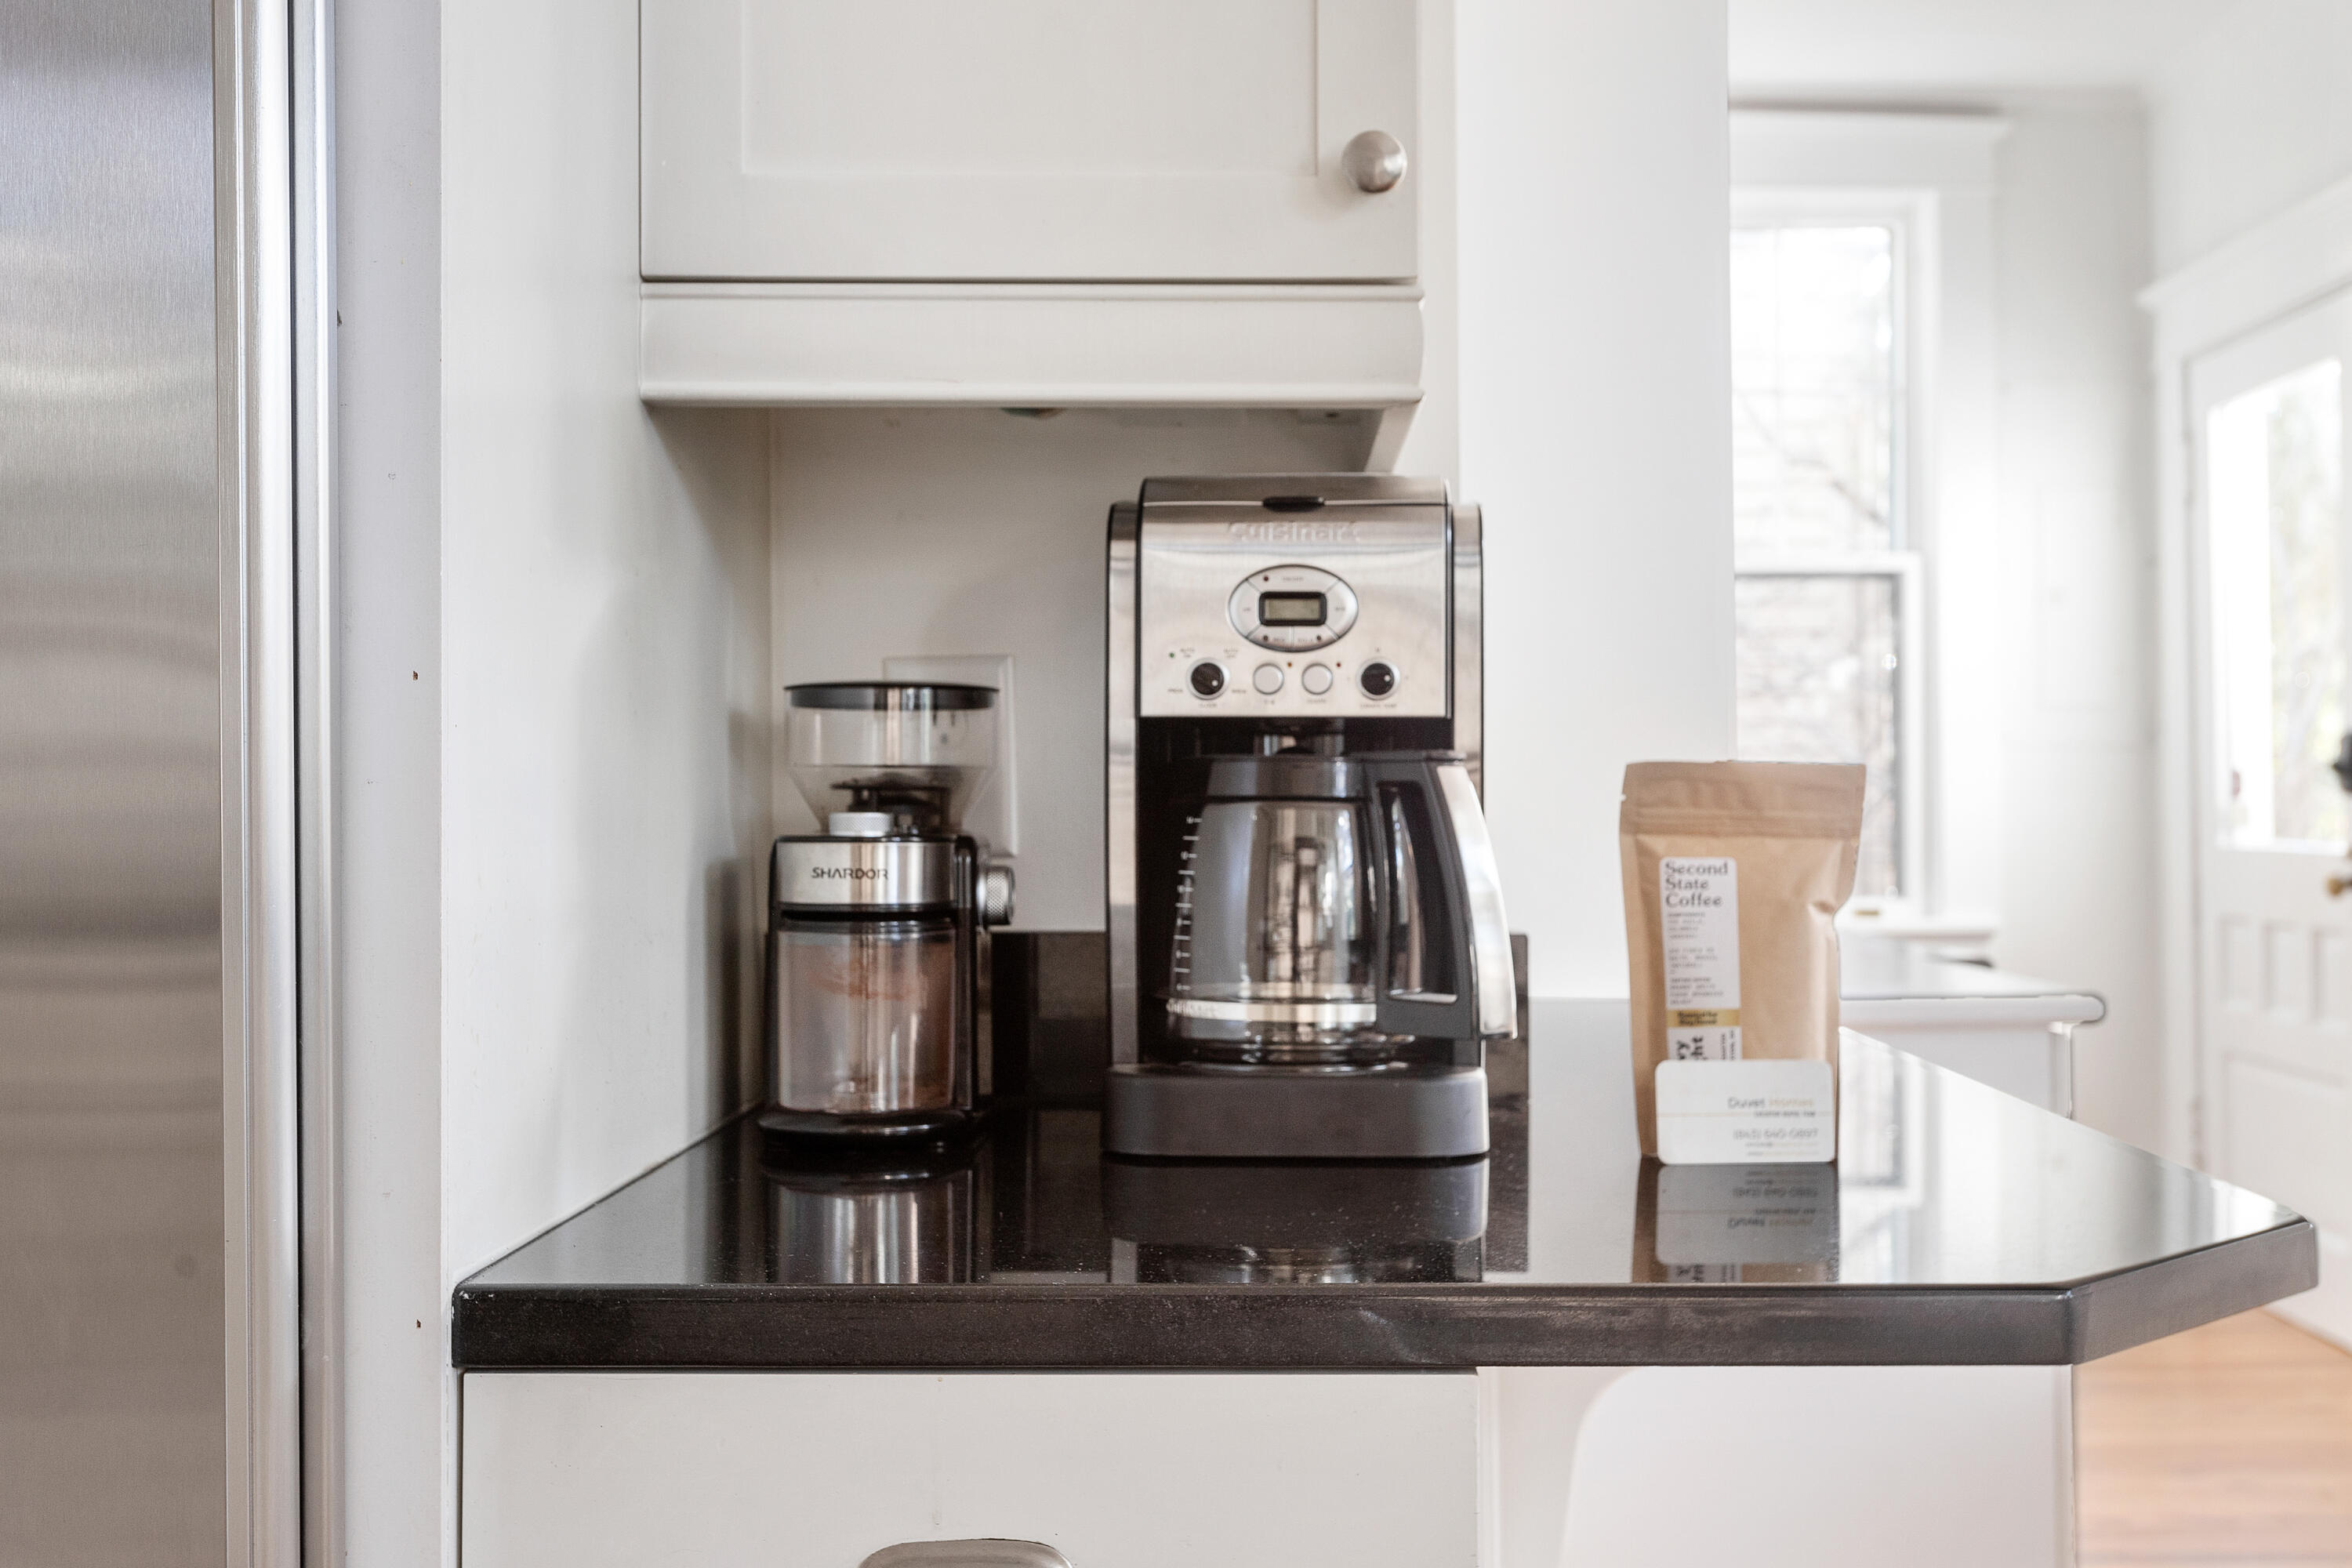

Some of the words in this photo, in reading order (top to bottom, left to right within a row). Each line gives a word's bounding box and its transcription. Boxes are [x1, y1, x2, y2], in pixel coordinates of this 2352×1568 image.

[811, 866, 888, 880] SHARDOR
[1664, 859, 1729, 876] Second
[1665, 875, 1708, 891] State
[1665, 891, 1723, 908] Coffee
[1728, 1097, 1766, 1109] Duvet
